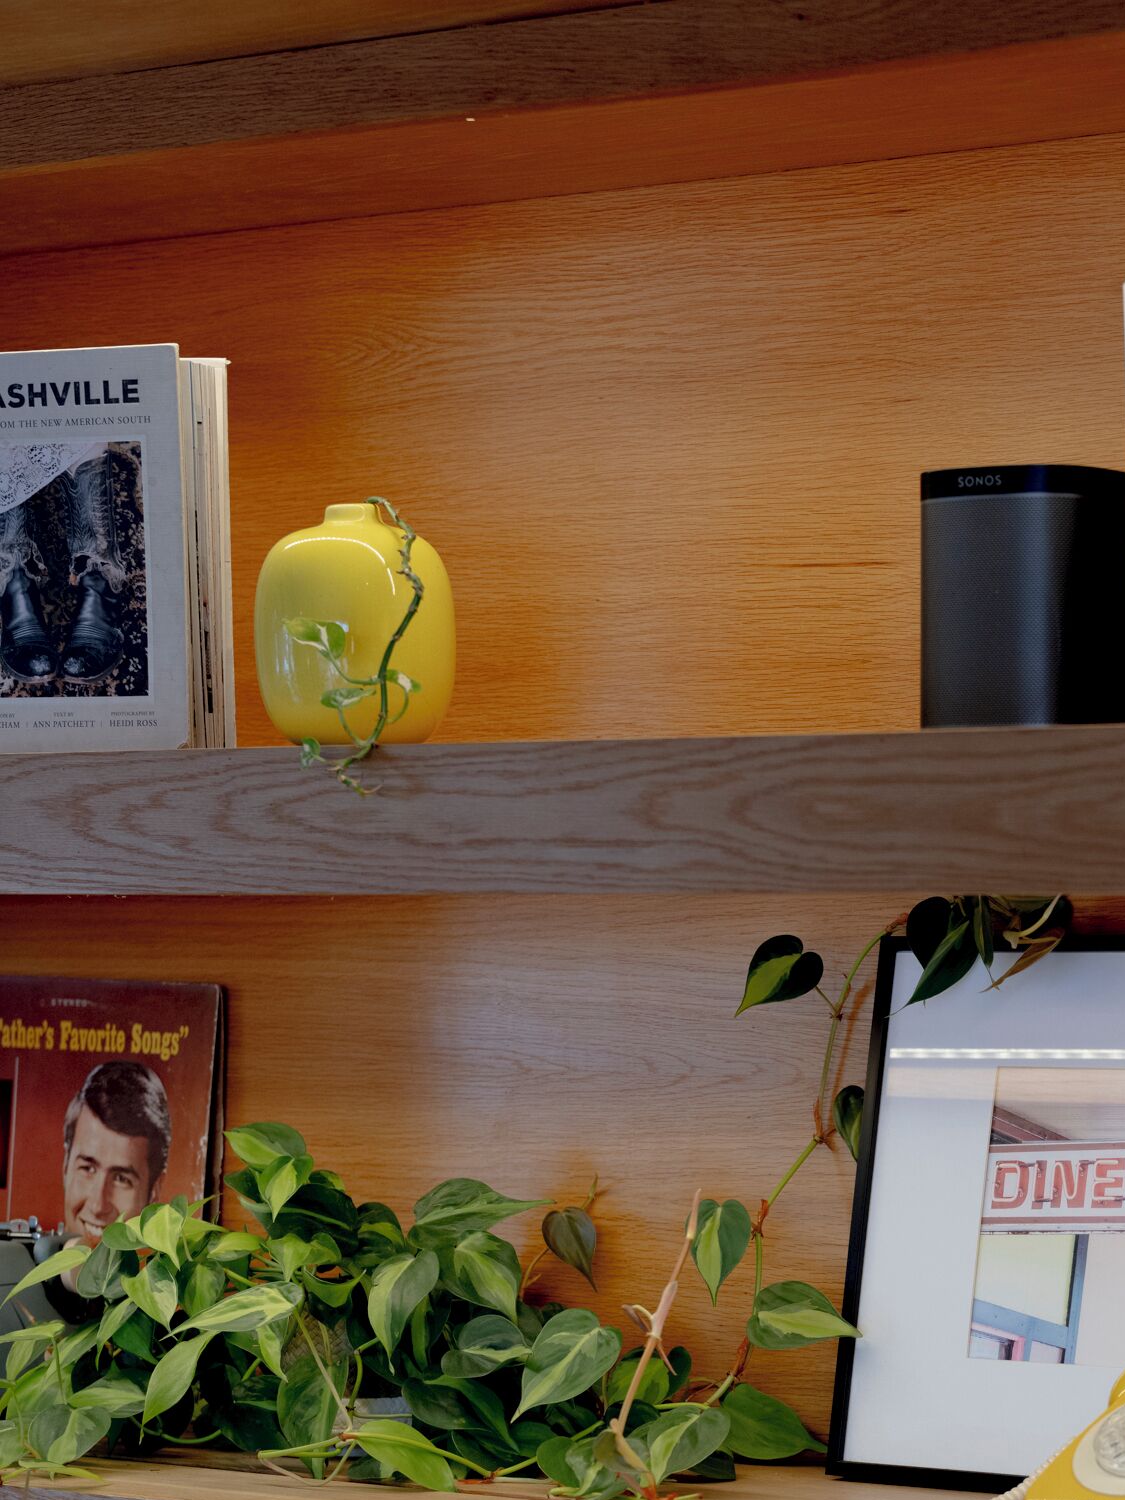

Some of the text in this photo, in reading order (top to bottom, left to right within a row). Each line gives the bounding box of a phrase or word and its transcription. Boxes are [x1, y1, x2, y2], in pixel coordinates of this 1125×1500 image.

[0, 378, 140, 409] SHVILLE
[19, 419, 39, 429] THE
[41, 418, 63, 427] NEW
[65, 417, 115, 427] AMERICAN
[118, 415, 151, 424] SOUTH
[957, 474, 1002, 488] SONOS
[0, 721, 20, 729] HAM
[32, 720, 96, 729] ANN PATCHETT
[109, 719, 158, 728] HEIDI ROSS
[0, 1018, 54, 1049] ather's
[59, 1019, 126, 1053] Favorite
